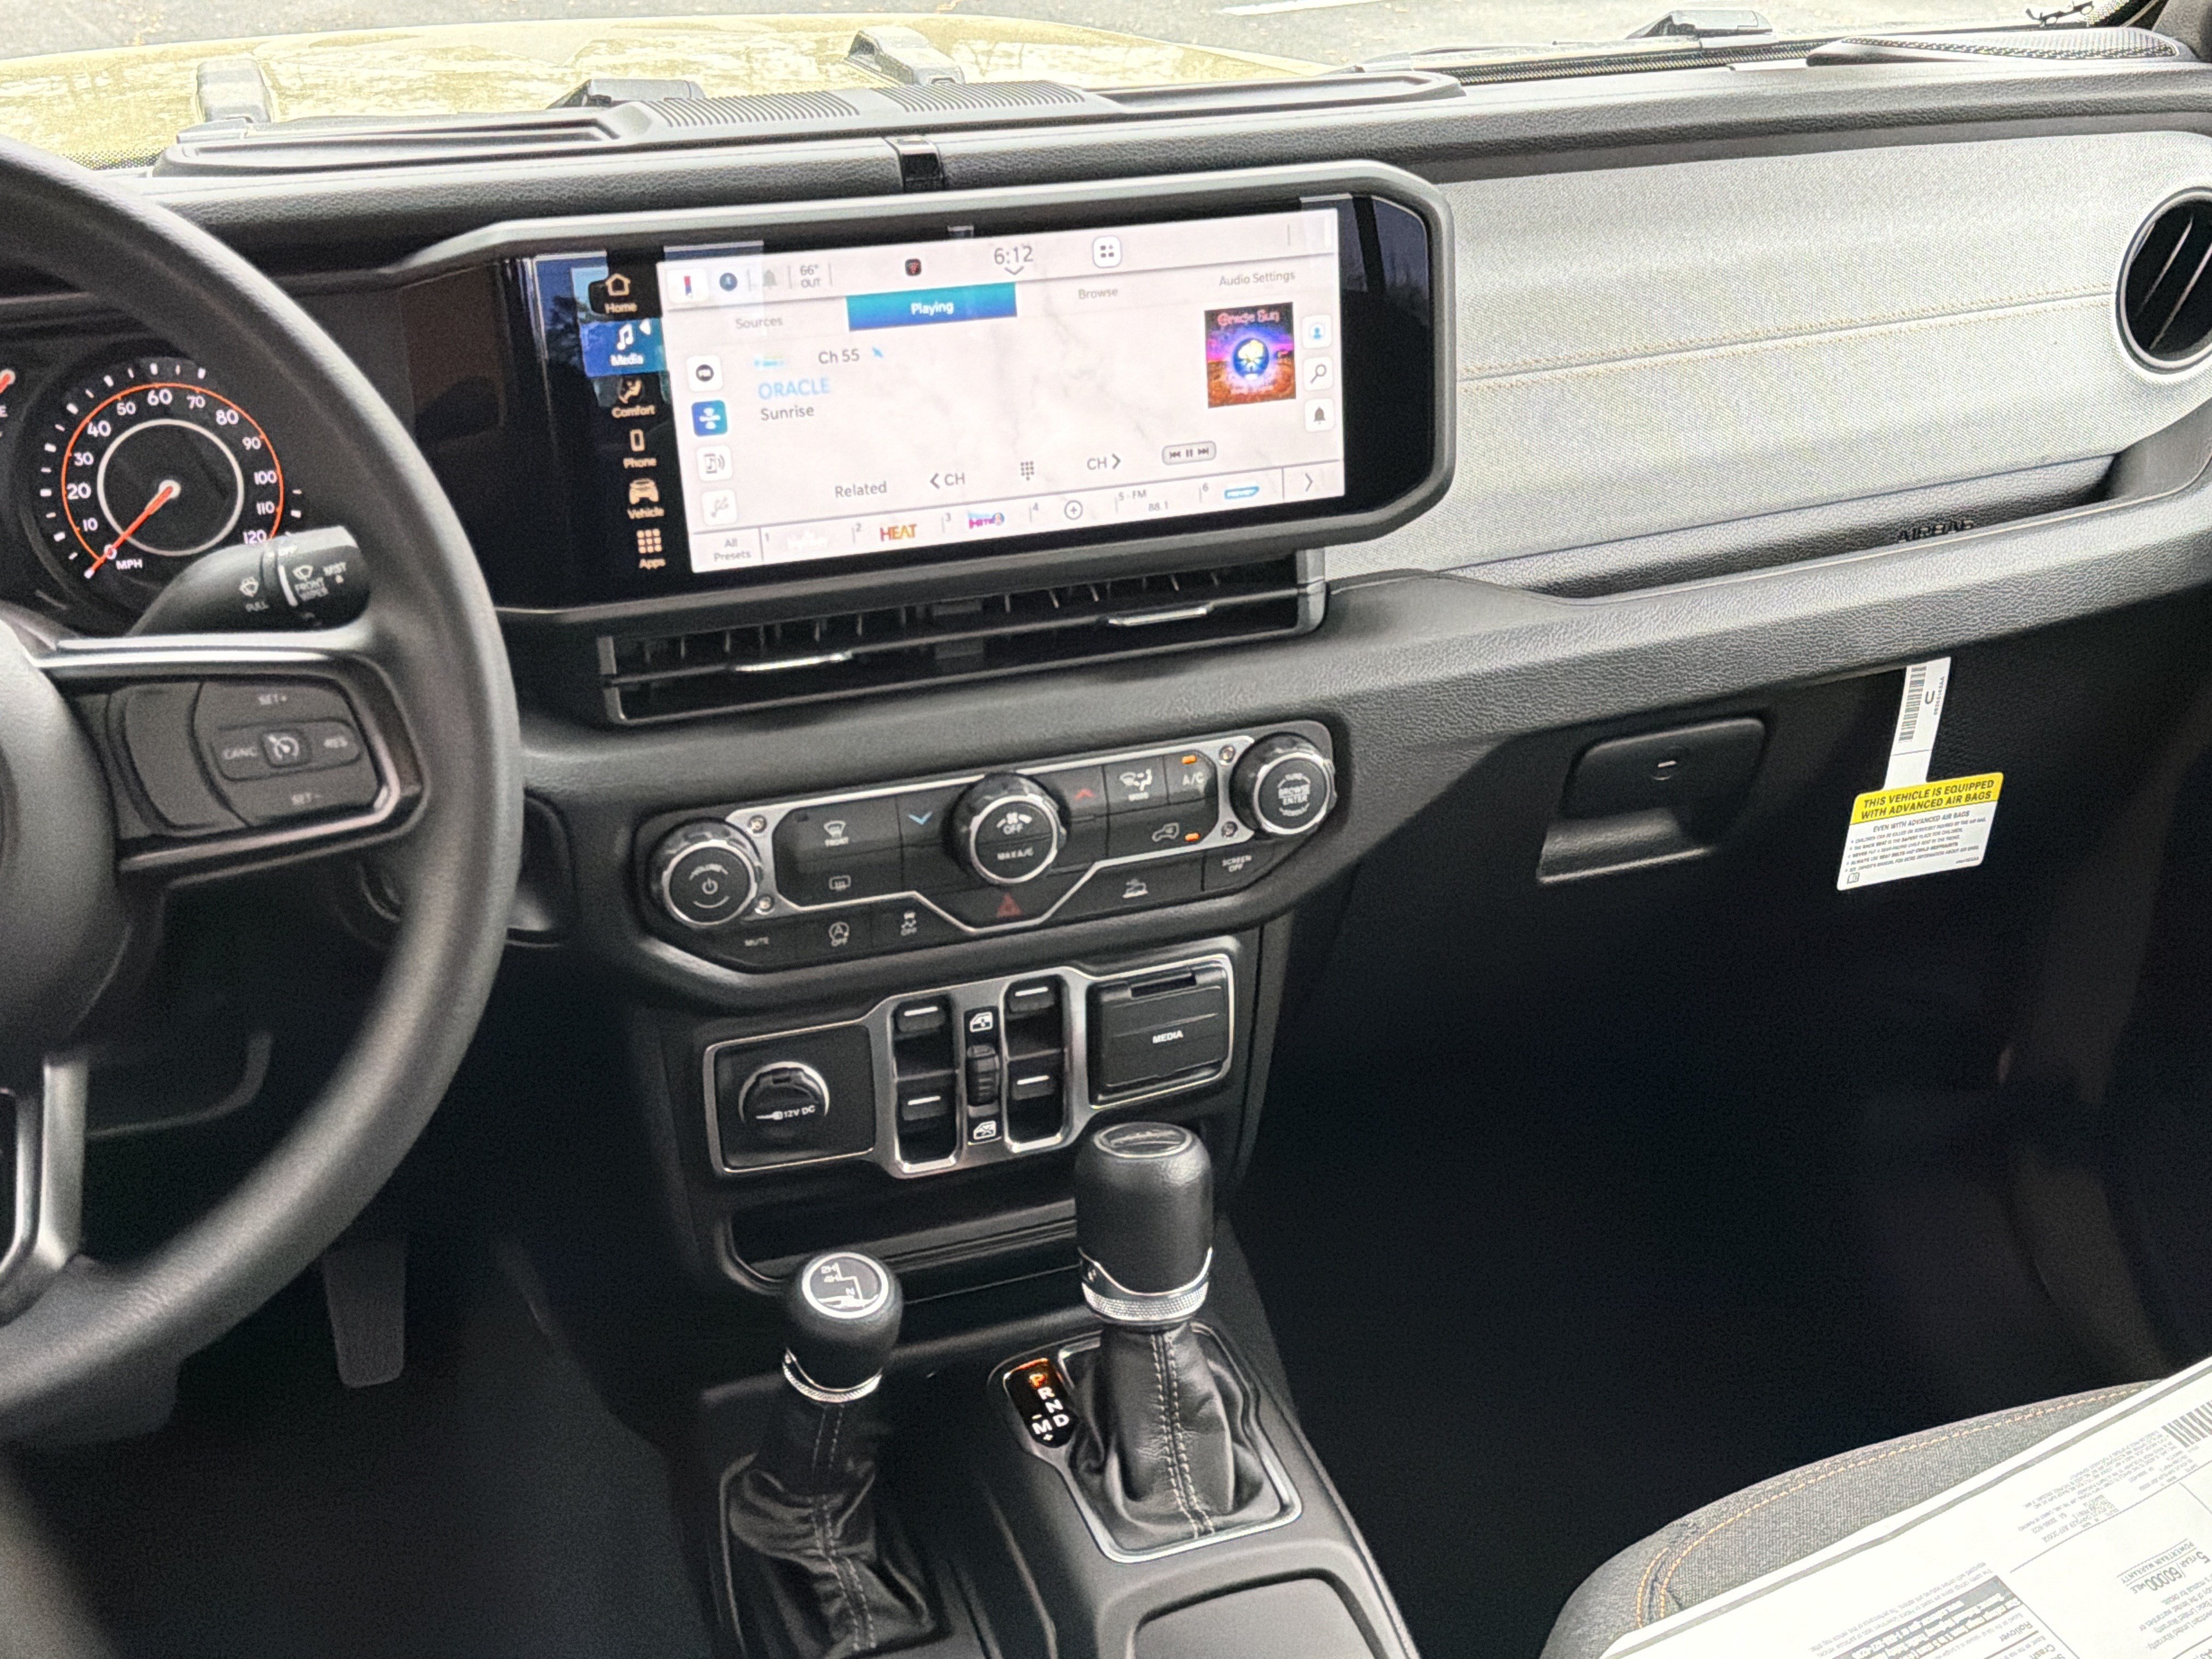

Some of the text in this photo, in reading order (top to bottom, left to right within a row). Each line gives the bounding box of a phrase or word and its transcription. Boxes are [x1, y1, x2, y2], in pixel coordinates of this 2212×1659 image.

[994, 245, 1034, 266] 6:12
[801, 278, 821, 289] OUT
[1219, 269, 1295, 287] Audio Settings
[1078, 287, 1118, 300] Browse
[605, 302, 637, 314] Home
[910, 300, 954, 315] Playing
[735, 315, 783, 330] Sources
[610, 353, 644, 366] Media
[818, 348, 860, 365] Ch 55
[758, 377, 830, 400] ORACLE
[147, 389, 172, 405] 60
[187, 395, 206, 409] 70
[116, 402, 137, 416] 50
[611, 405, 656, 419] Comfort
[760, 405, 815, 421] Sunrise
[216, 409, 239, 425] 80
[87, 420, 111, 437] 40
[242, 437, 262, 450] 90
[74, 452, 94, 466] 30
[623, 457, 657, 469] Phone
[1086, 456, 1108, 471] CH
[253, 471, 276, 484] 100
[944, 472, 966, 487] CH
[66, 483, 92, 499] 20
[835, 481, 887, 498] Related
[1132, 490, 1147, 499] FM
[1202, 484, 1209, 492] 6
[256, 502, 275, 514] 110
[627, 507, 664, 519] Vehicle
[1148, 501, 1169, 511] 88.1
[82, 518, 98, 531] 10
[856, 522, 861, 532] 2
[243, 531, 268, 544] 120
[880, 523, 917, 541] HEAT
[724, 538, 738, 548] All
[713, 551, 752, 562] Presets
[116, 559, 143, 571] MPH
[639, 558, 666, 570] Apps
[1925, 690, 1936, 704] U
[1182, 771, 1205, 786] A/C
[1279, 785, 1310, 799] BROWSE
[1864, 780, 1994, 809] THIS VEHICLE IS EQUIPPED
[1282, 795, 1308, 805] ENTER
[1861, 791, 1991, 820] WITH ADVANCED AIR BAGS
[1908, 815, 1940, 827] ADVANCED
[1003, 823, 1023, 835] OFF
[1222, 855, 1251, 867] SCREEN
[1228, 863, 1243, 872] OFF
[744, 936, 769, 947] MUTE
[831, 938, 848, 947] OFF
[1153, 1030, 1184, 1043] MEDIA
[783, 1104, 816, 1118] 12V DC
[1029, 1373, 1046, 1387] P
[1038, 1386, 1055, 1401] R
[1046, 1401, 1064, 1414] N
[1032, 1420, 1052, 1434] M
[1054, 1414, 1069, 1428] D
[2120, 1541, 2194, 1584] POWERTRAIN WARRANTY
[1999, 1621, 2033, 1642] Rollover
